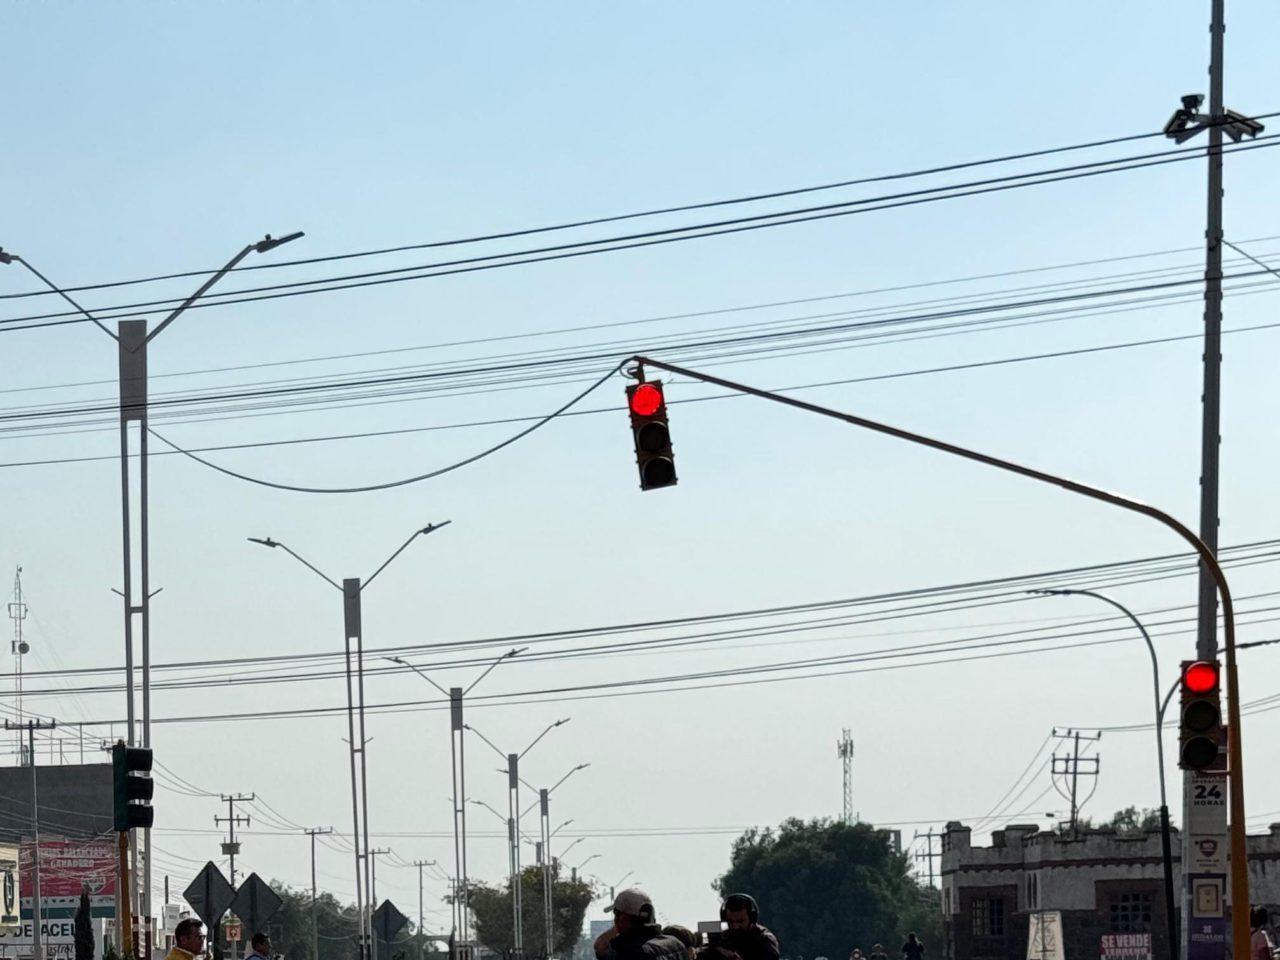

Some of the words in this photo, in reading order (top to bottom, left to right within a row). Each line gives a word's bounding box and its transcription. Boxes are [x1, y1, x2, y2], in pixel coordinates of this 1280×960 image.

[1194, 785, 1222, 800] 24
[1101, 935, 1116, 948] SE
[1116, 934, 1149, 947] VENDE
